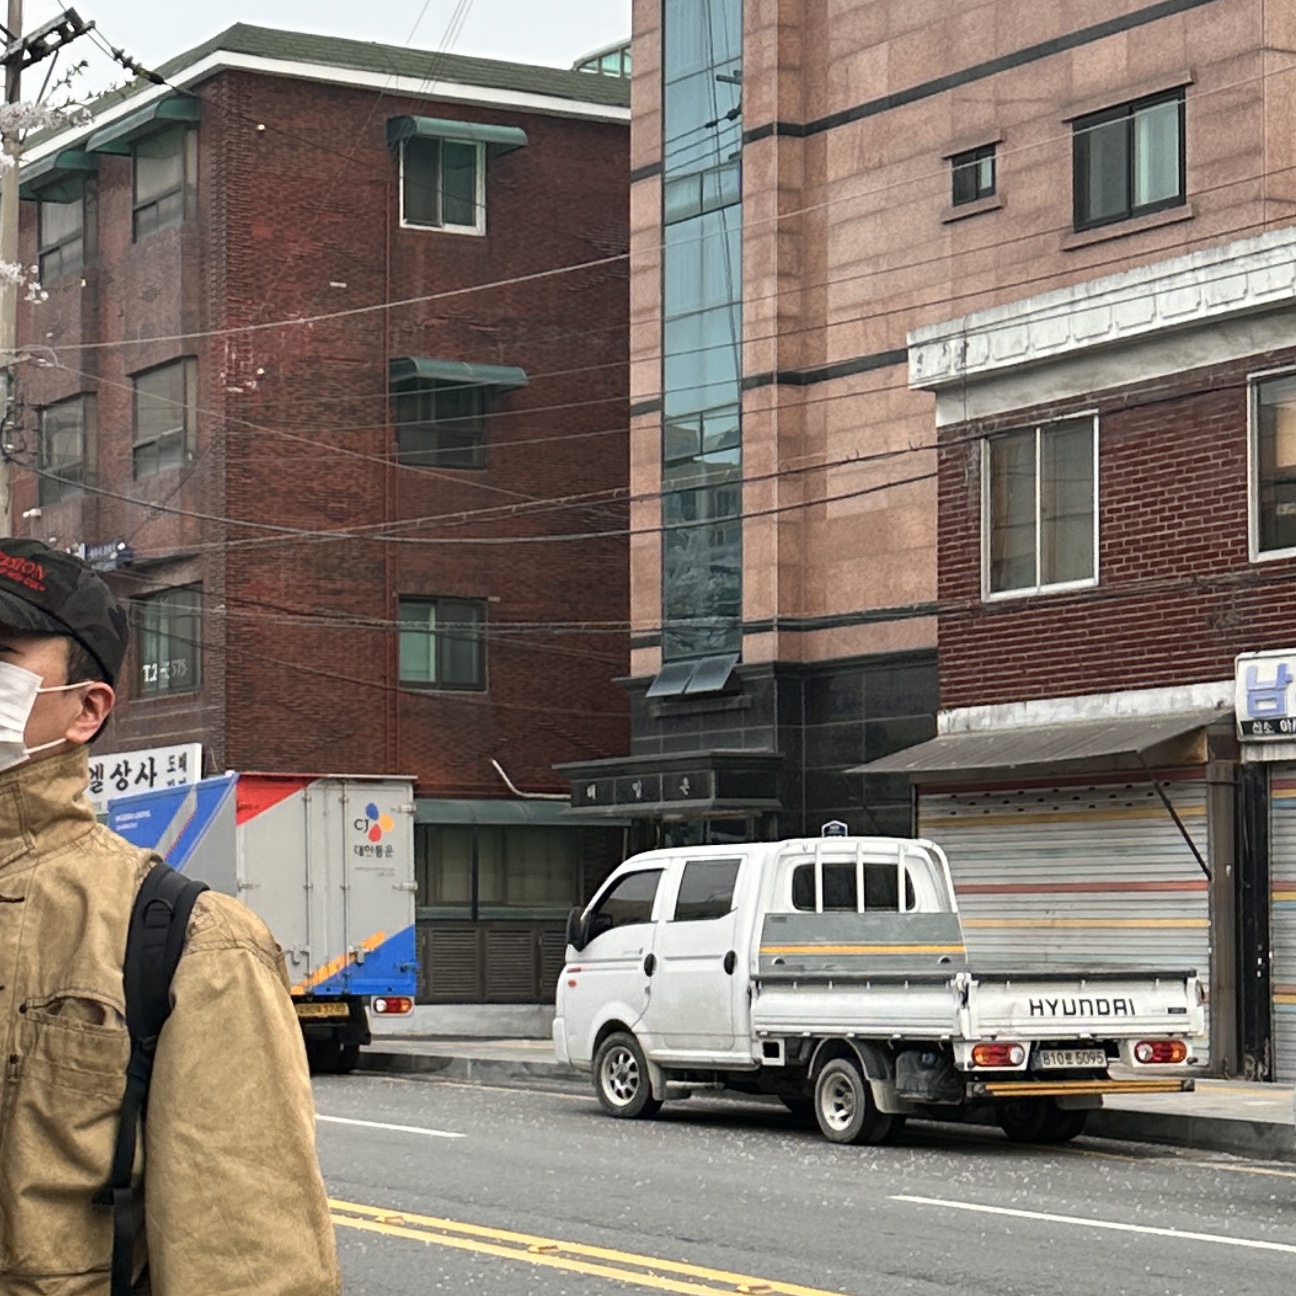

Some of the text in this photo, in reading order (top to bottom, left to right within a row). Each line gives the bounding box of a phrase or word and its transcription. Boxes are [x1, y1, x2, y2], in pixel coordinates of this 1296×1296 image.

[354, 817, 370, 833] CJ
[353, 845, 394, 858] 대한통운
[1028, 998, 1136, 1017] HYUNDAI
